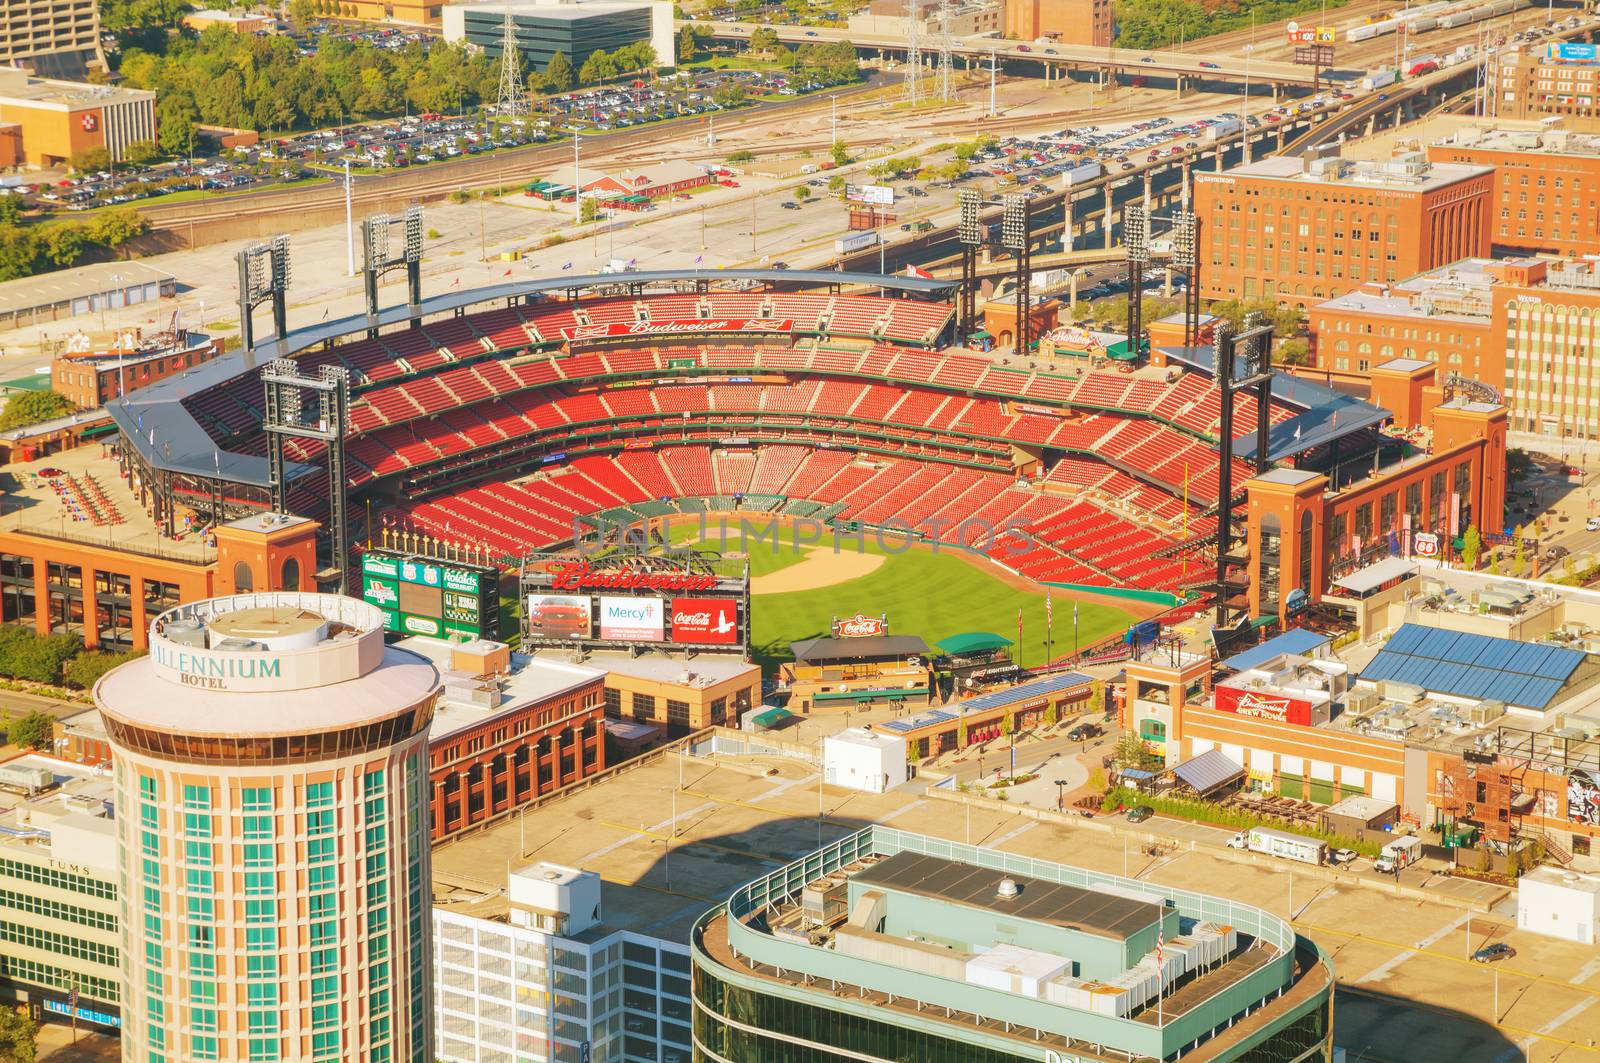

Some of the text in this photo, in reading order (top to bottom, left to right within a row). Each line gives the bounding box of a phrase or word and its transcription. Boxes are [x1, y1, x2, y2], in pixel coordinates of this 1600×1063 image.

[624, 320, 729, 333] Budweiser
[546, 561, 718, 590] Budweiser
[609, 607, 645, 621] Mercy
[181, 672, 228, 689] HOTEL
[48, 859, 90, 876] TUMS
